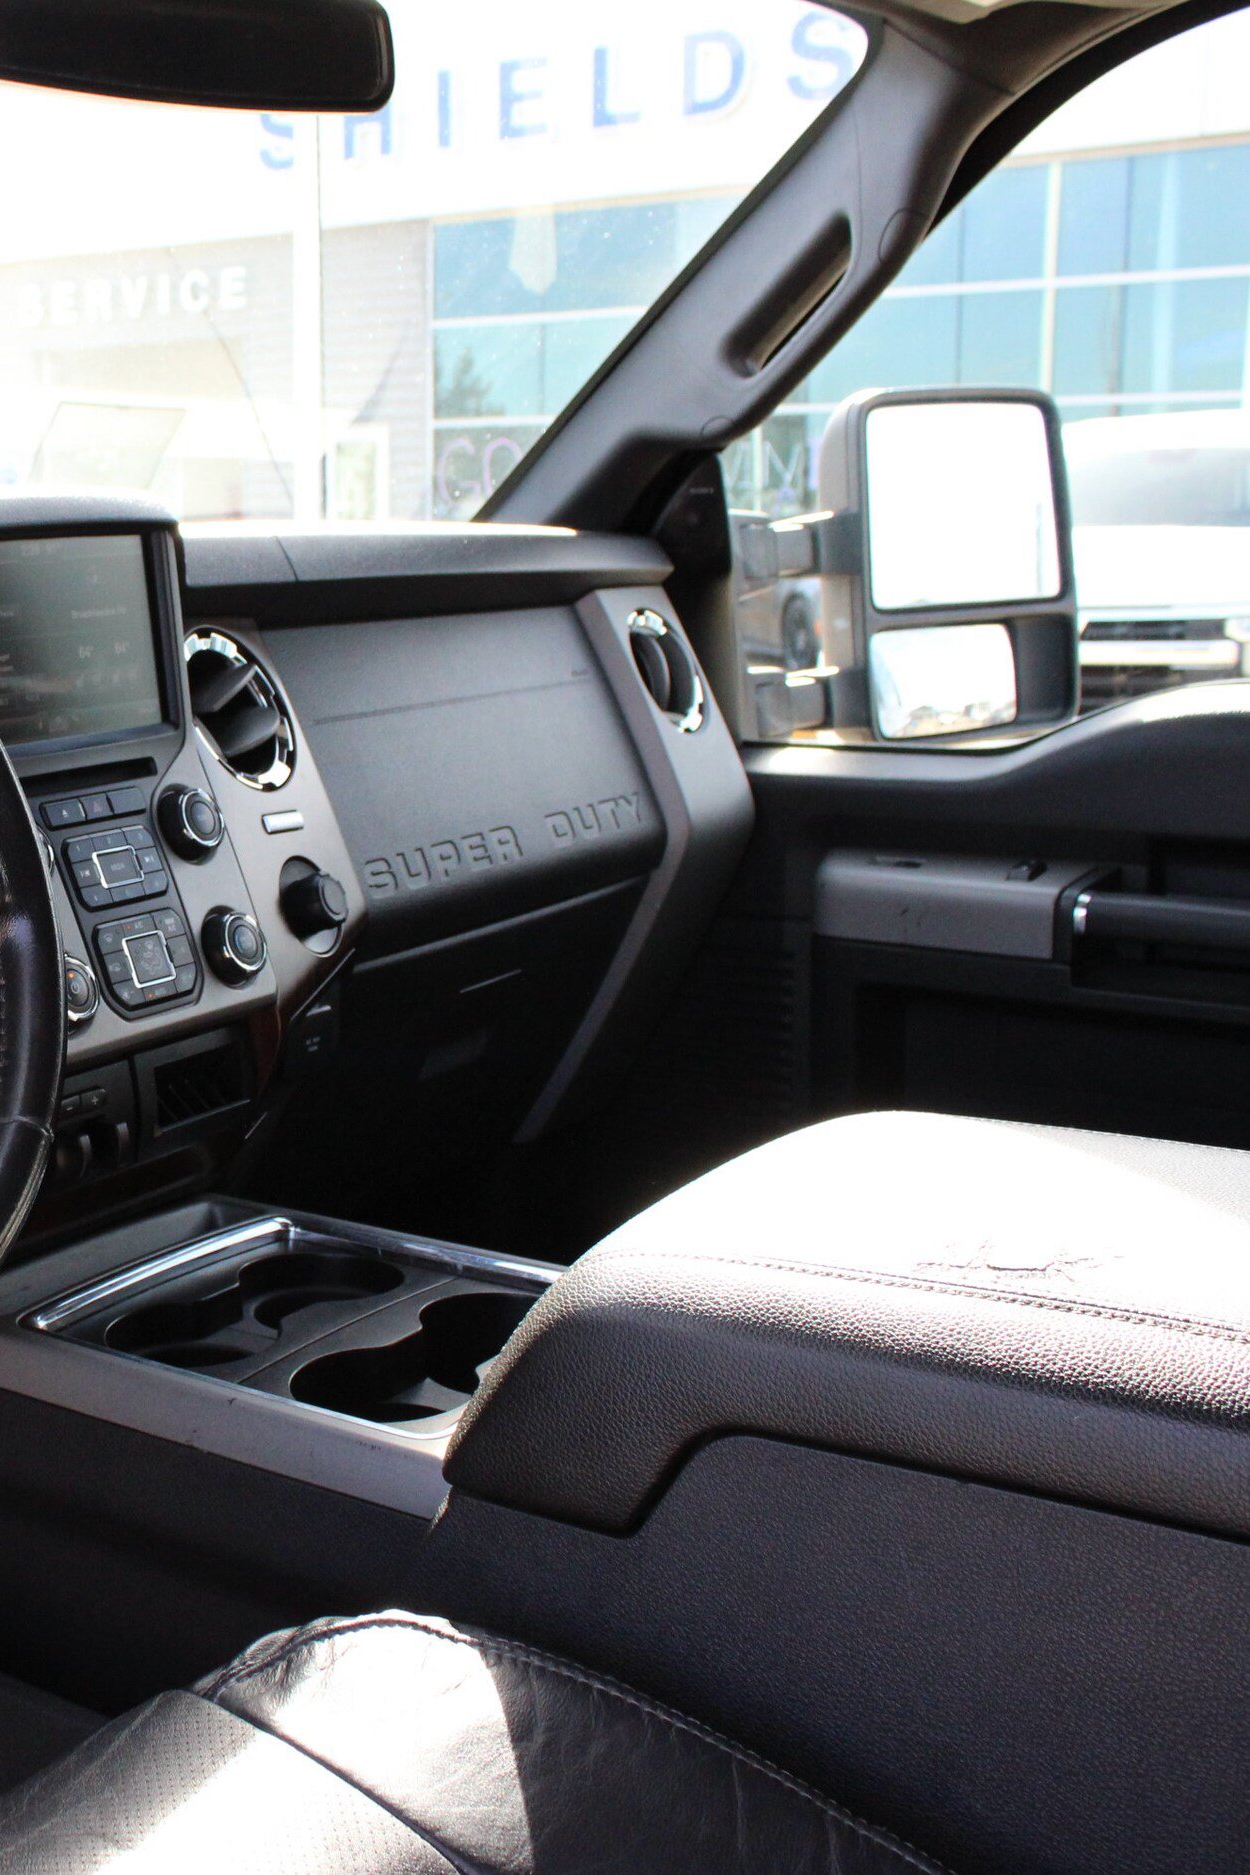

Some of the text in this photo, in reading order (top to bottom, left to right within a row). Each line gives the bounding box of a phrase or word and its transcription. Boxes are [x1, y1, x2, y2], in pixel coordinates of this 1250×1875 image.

[259, 9, 855, 170] SHIELDS
[16, 265, 248, 327] SERVICE
[363, 792, 644, 899] SUPER DUTY
